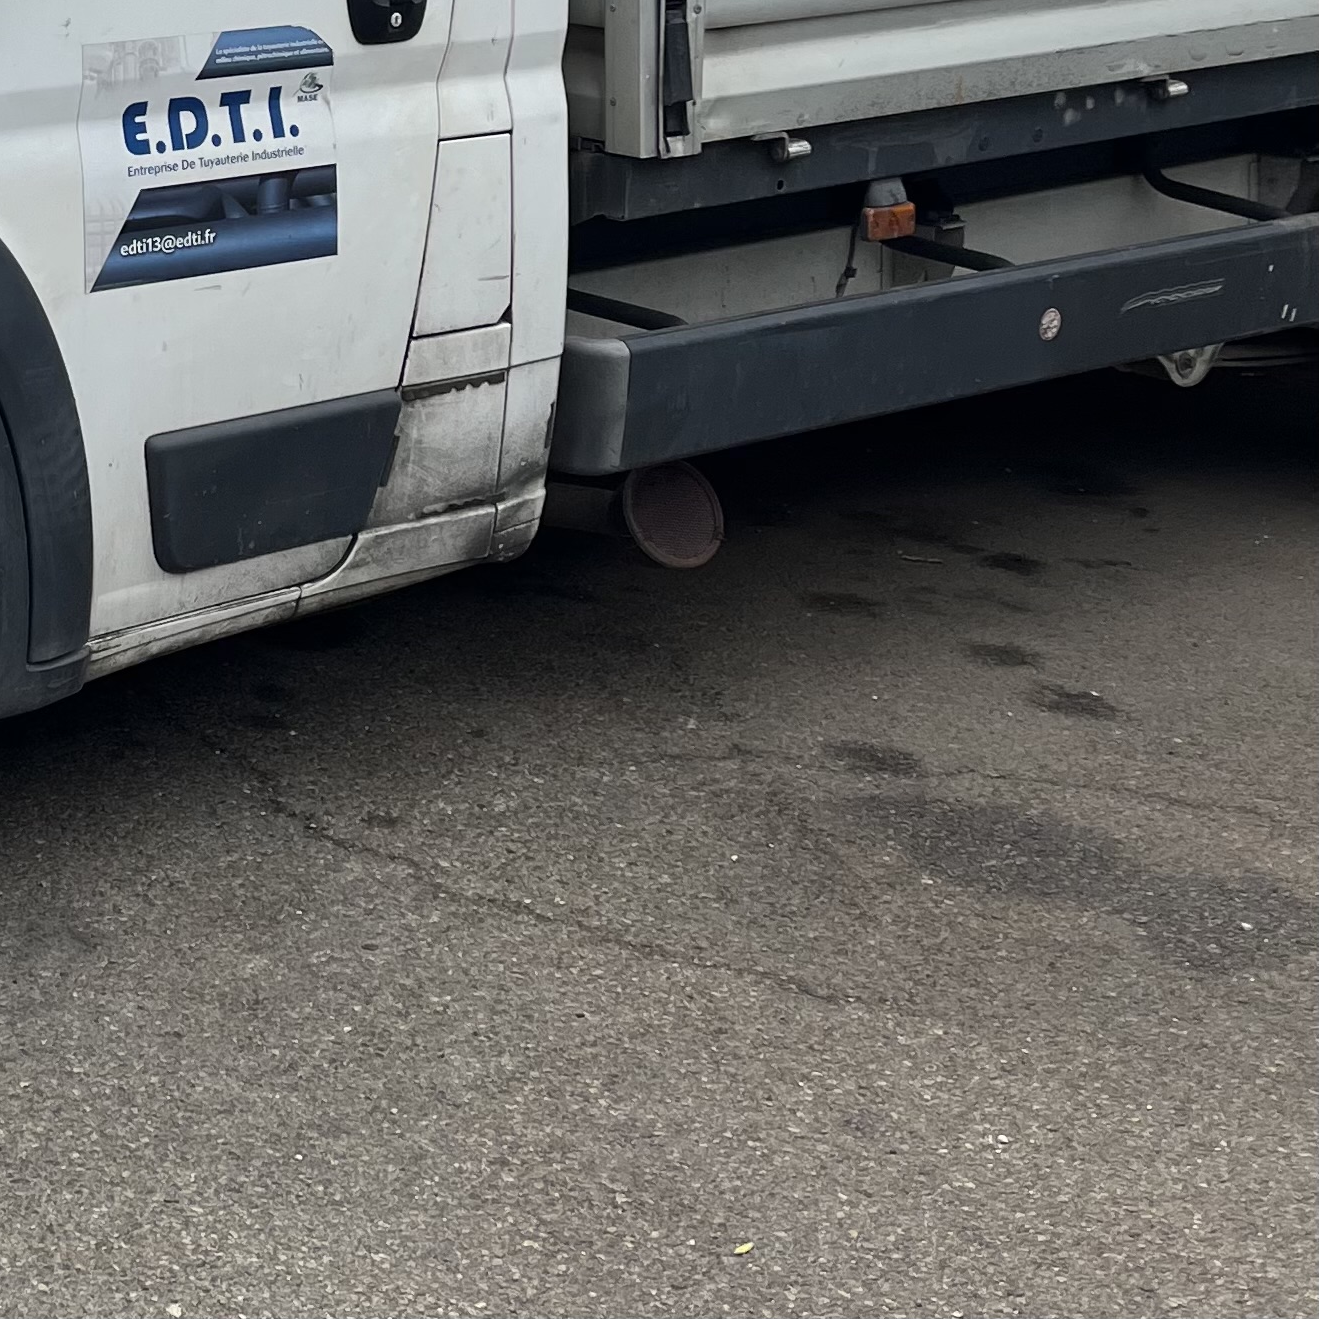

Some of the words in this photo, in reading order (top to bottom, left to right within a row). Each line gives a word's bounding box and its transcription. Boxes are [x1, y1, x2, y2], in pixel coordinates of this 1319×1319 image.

[121, 85, 300, 156] E.D.T.I.
[127, 161, 179, 177] Entreprise
[182, 159, 196, 170] De
[198, 152, 249, 169] Tuyauterie
[251, 145, 305, 161] Industrielle
[120, 228, 217, 256] edti13@edti.fr
